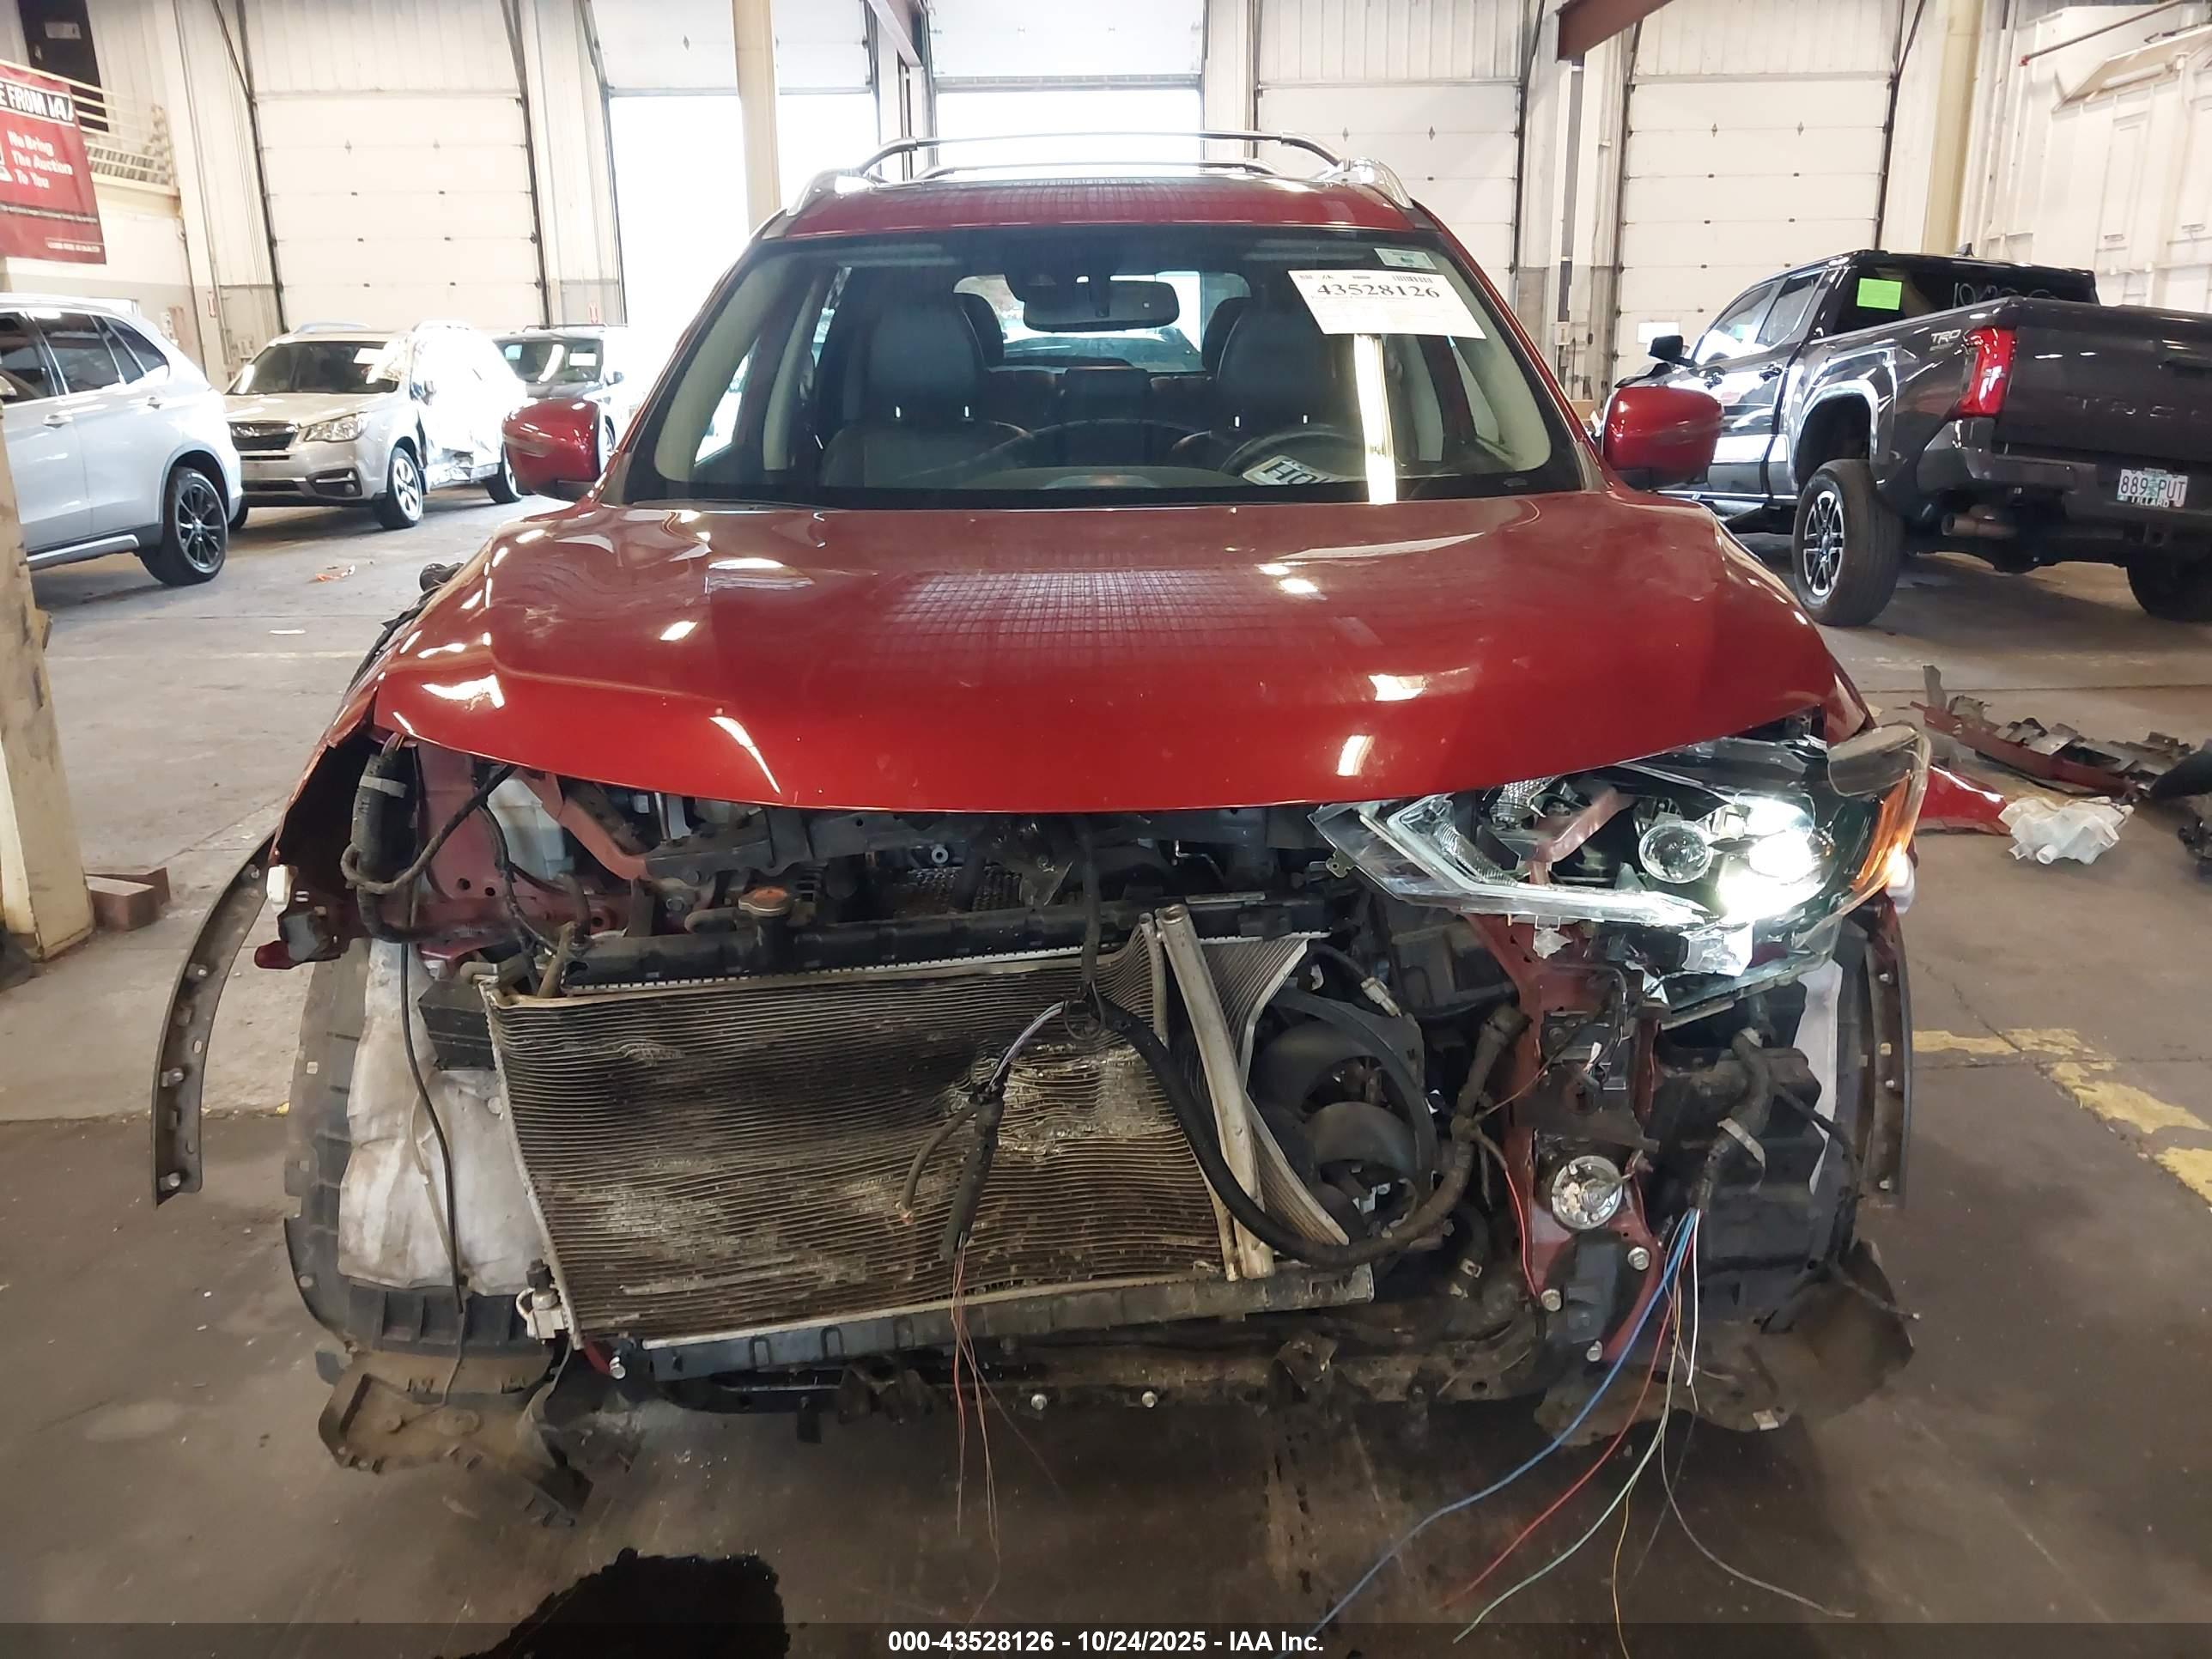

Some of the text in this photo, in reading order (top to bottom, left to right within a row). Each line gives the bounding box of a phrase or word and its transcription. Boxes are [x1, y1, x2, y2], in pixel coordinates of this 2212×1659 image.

[6, 84, 48, 116] FROM
[24, 134, 54, 157] Bring
[11, 149, 73, 175] The Auction
[15, 168, 50, 188] To You
[1317, 283, 1440, 299] 43528126
[2120, 475, 2186, 501] 889 PUT
